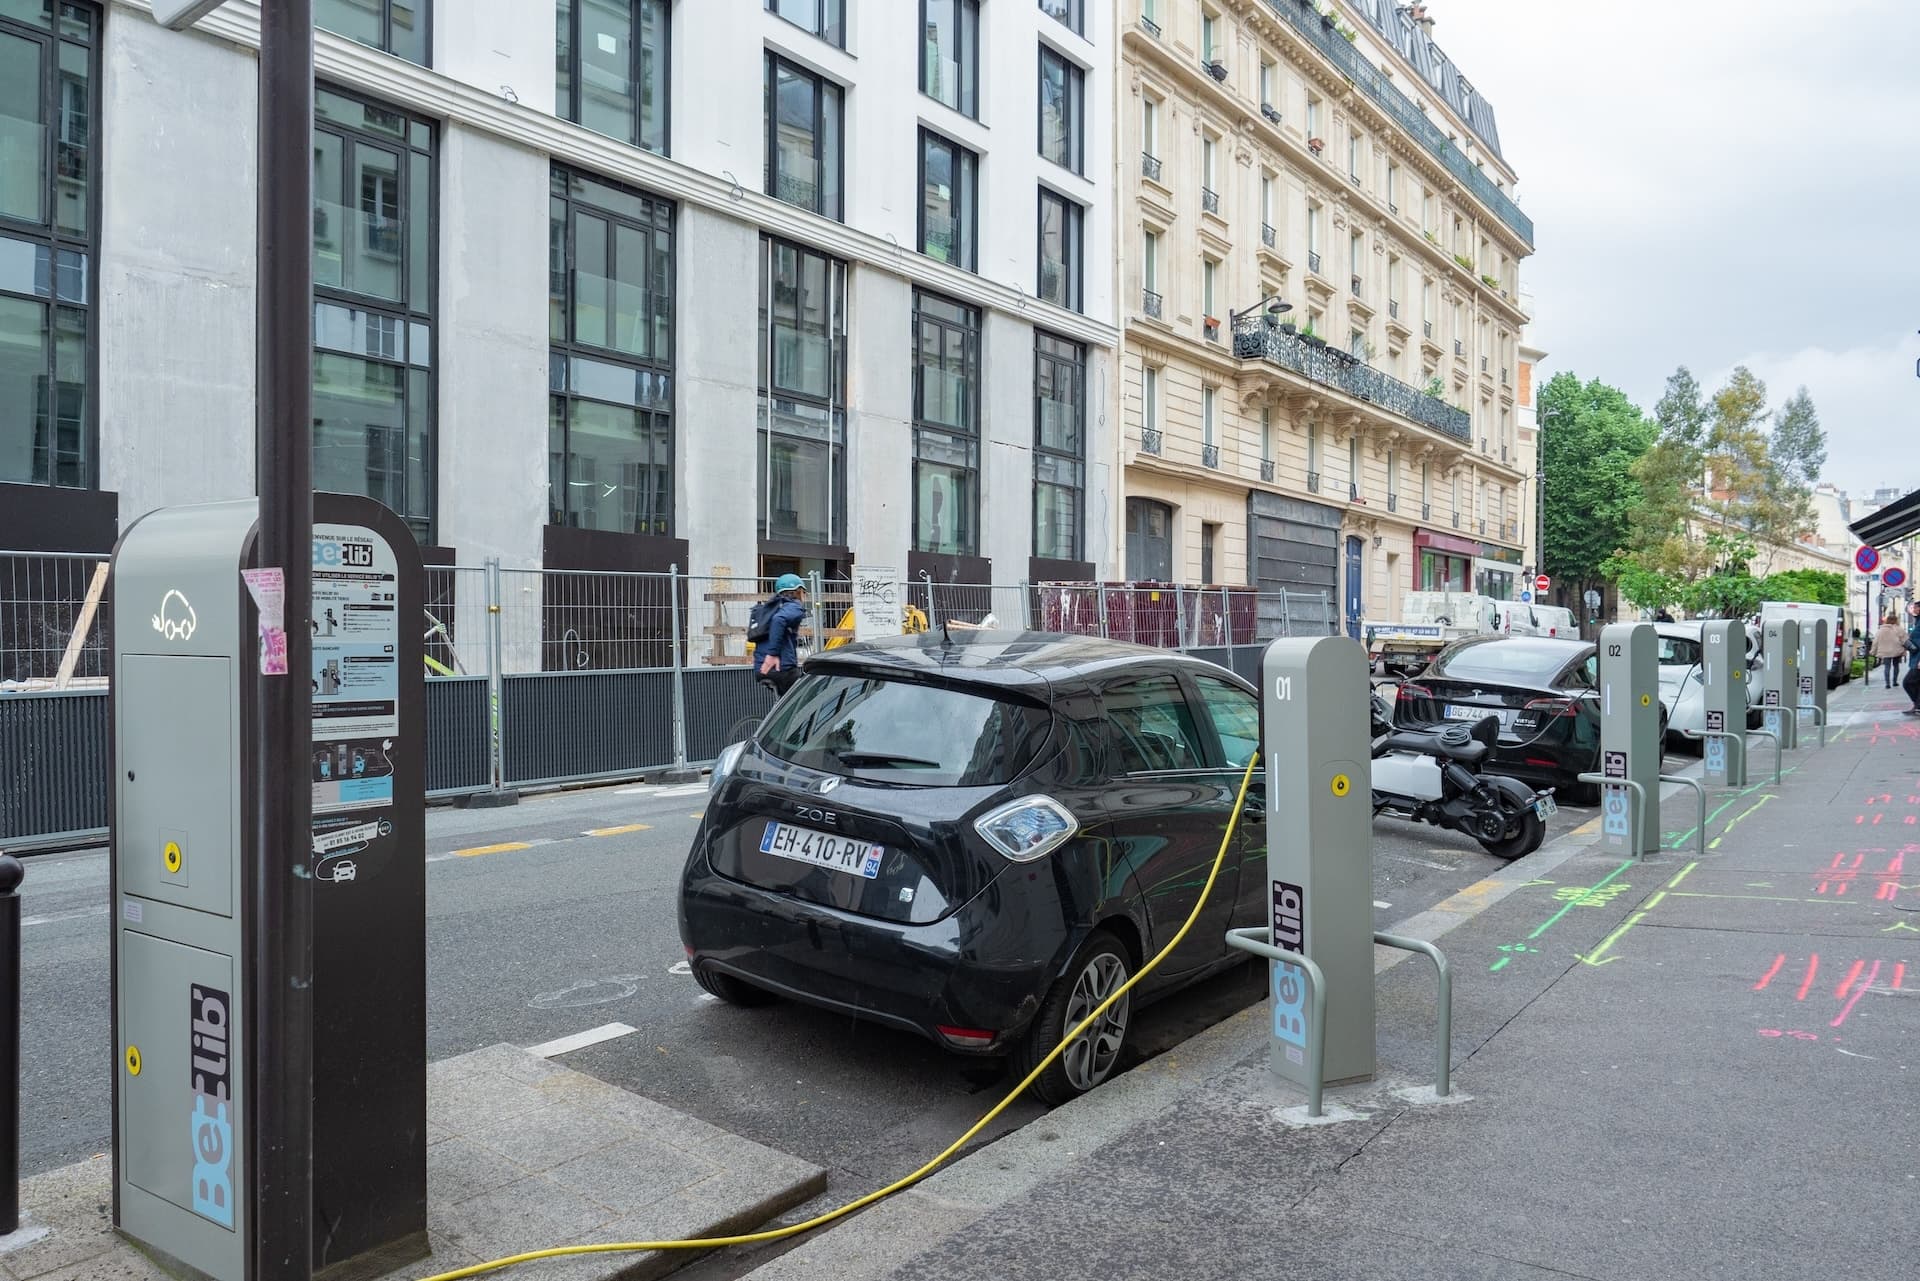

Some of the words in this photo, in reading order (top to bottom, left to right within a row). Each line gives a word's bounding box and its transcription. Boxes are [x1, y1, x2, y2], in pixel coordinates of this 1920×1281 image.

[1710, 634, 1720, 644] 03
[1768, 630, 1777, 638] 04
[1608, 645, 1621, 657] 02
[1275, 676, 1291, 700] 01
[795, 806, 837, 825] ZOE
[773, 827, 867, 869] EH-410-RV
[866, 860, 877, 875] 94
[191, 983, 232, 1228] Belib'
